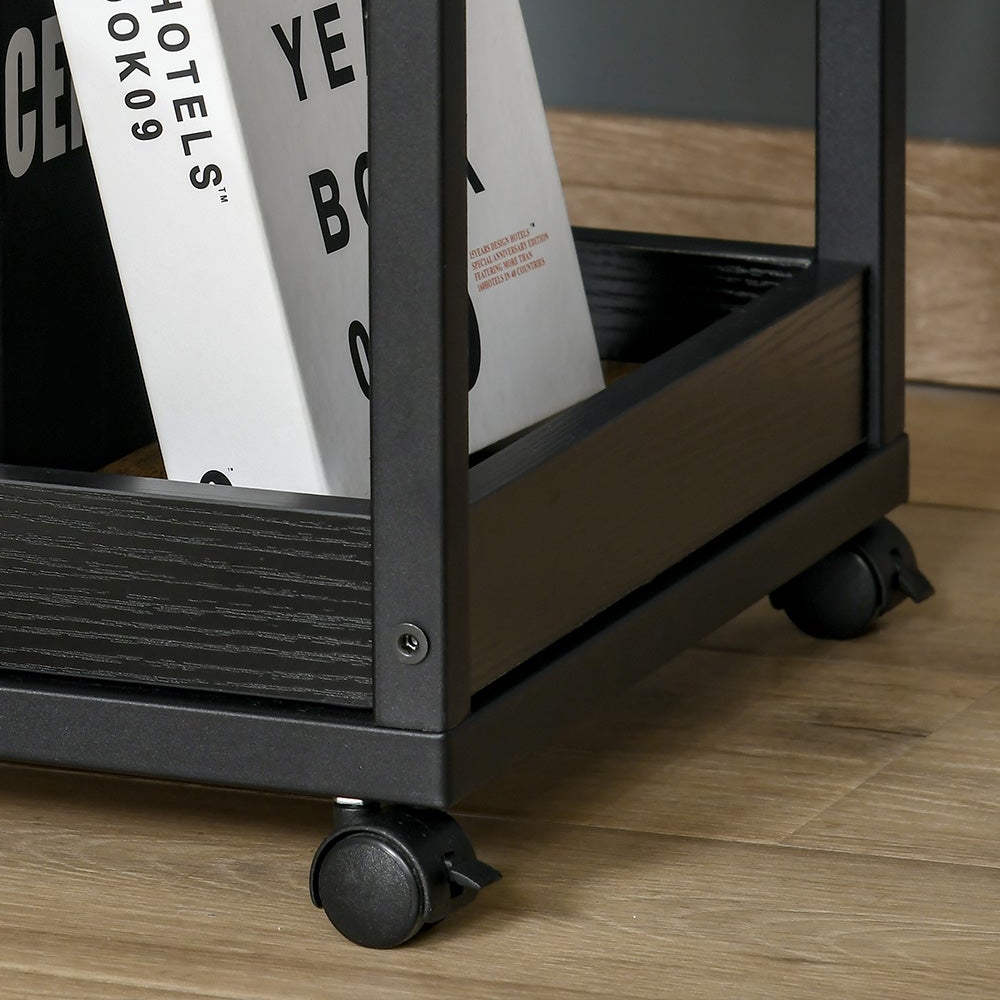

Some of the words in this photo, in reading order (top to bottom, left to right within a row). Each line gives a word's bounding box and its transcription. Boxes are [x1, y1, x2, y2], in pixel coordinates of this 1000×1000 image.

[5, 15, 83, 178] CE
[490, 237, 509, 251] DESIGN
[510, 229, 530, 243] HOTELS
[471, 256, 492, 270] SPECIAL
[474, 263, 503, 281] FEATURING
[503, 257, 518, 268] MORE
[518, 251, 533, 263] THAN
[517, 257, 546, 276] COUNTRIES
